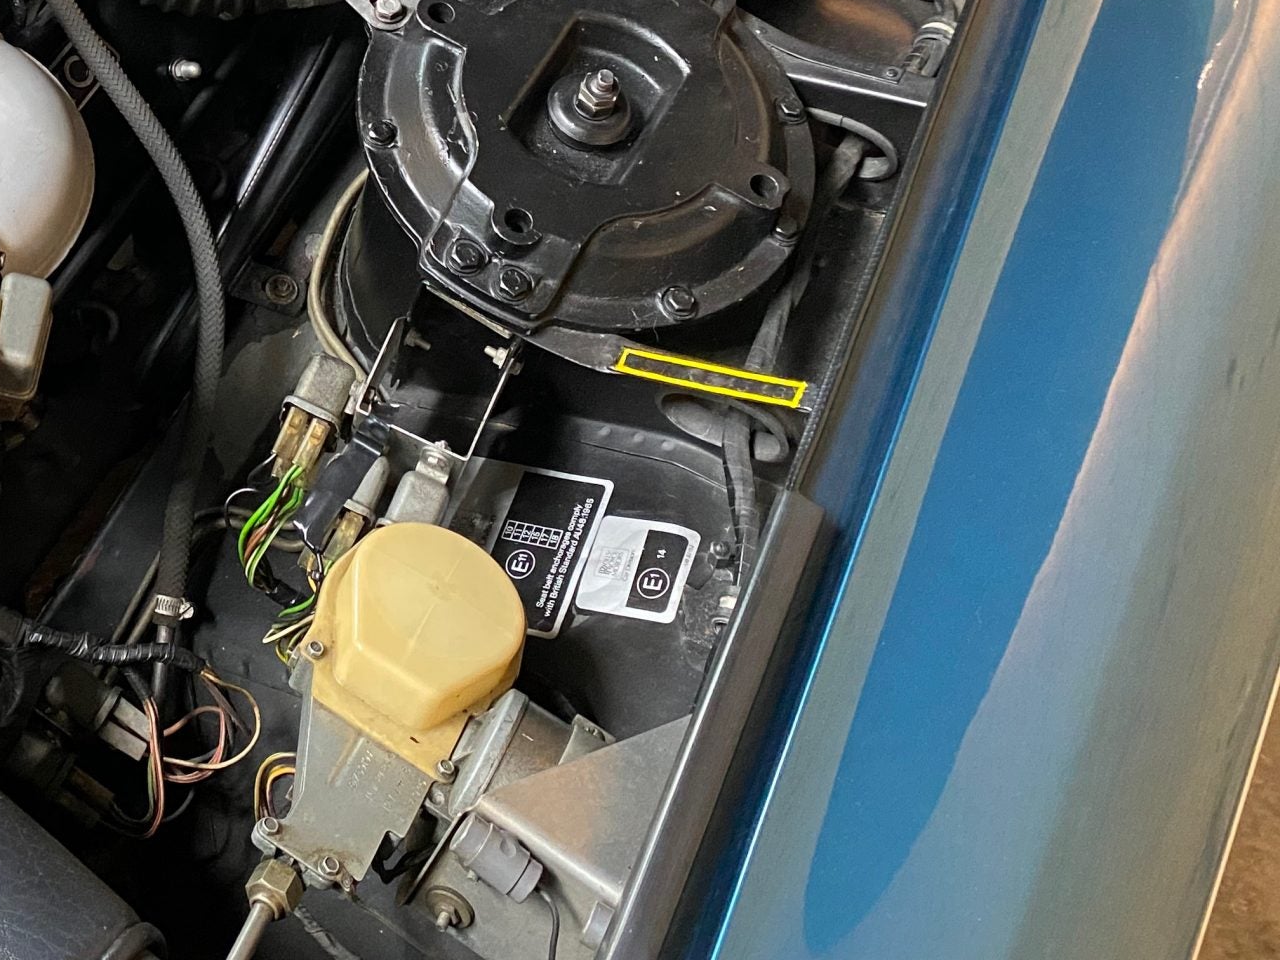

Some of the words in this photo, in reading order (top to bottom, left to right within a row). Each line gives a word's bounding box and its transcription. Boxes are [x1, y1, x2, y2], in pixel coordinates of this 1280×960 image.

[504, 525, 514, 535] 10
[513, 527, 522, 537] 11
[522, 529, 531, 539] 12
[539, 532, 549, 542] 17
[549, 533, 559, 544] 18
[535, 588, 549, 608] Seat
[542, 573, 554, 590] belt
[549, 530, 572, 575] anchorages
[566, 502, 583, 532] comply
[655, 547, 667, 560] 14
[542, 598, 555, 617] with
[549, 573, 564, 598] British
[558, 538, 578, 574] Standard
